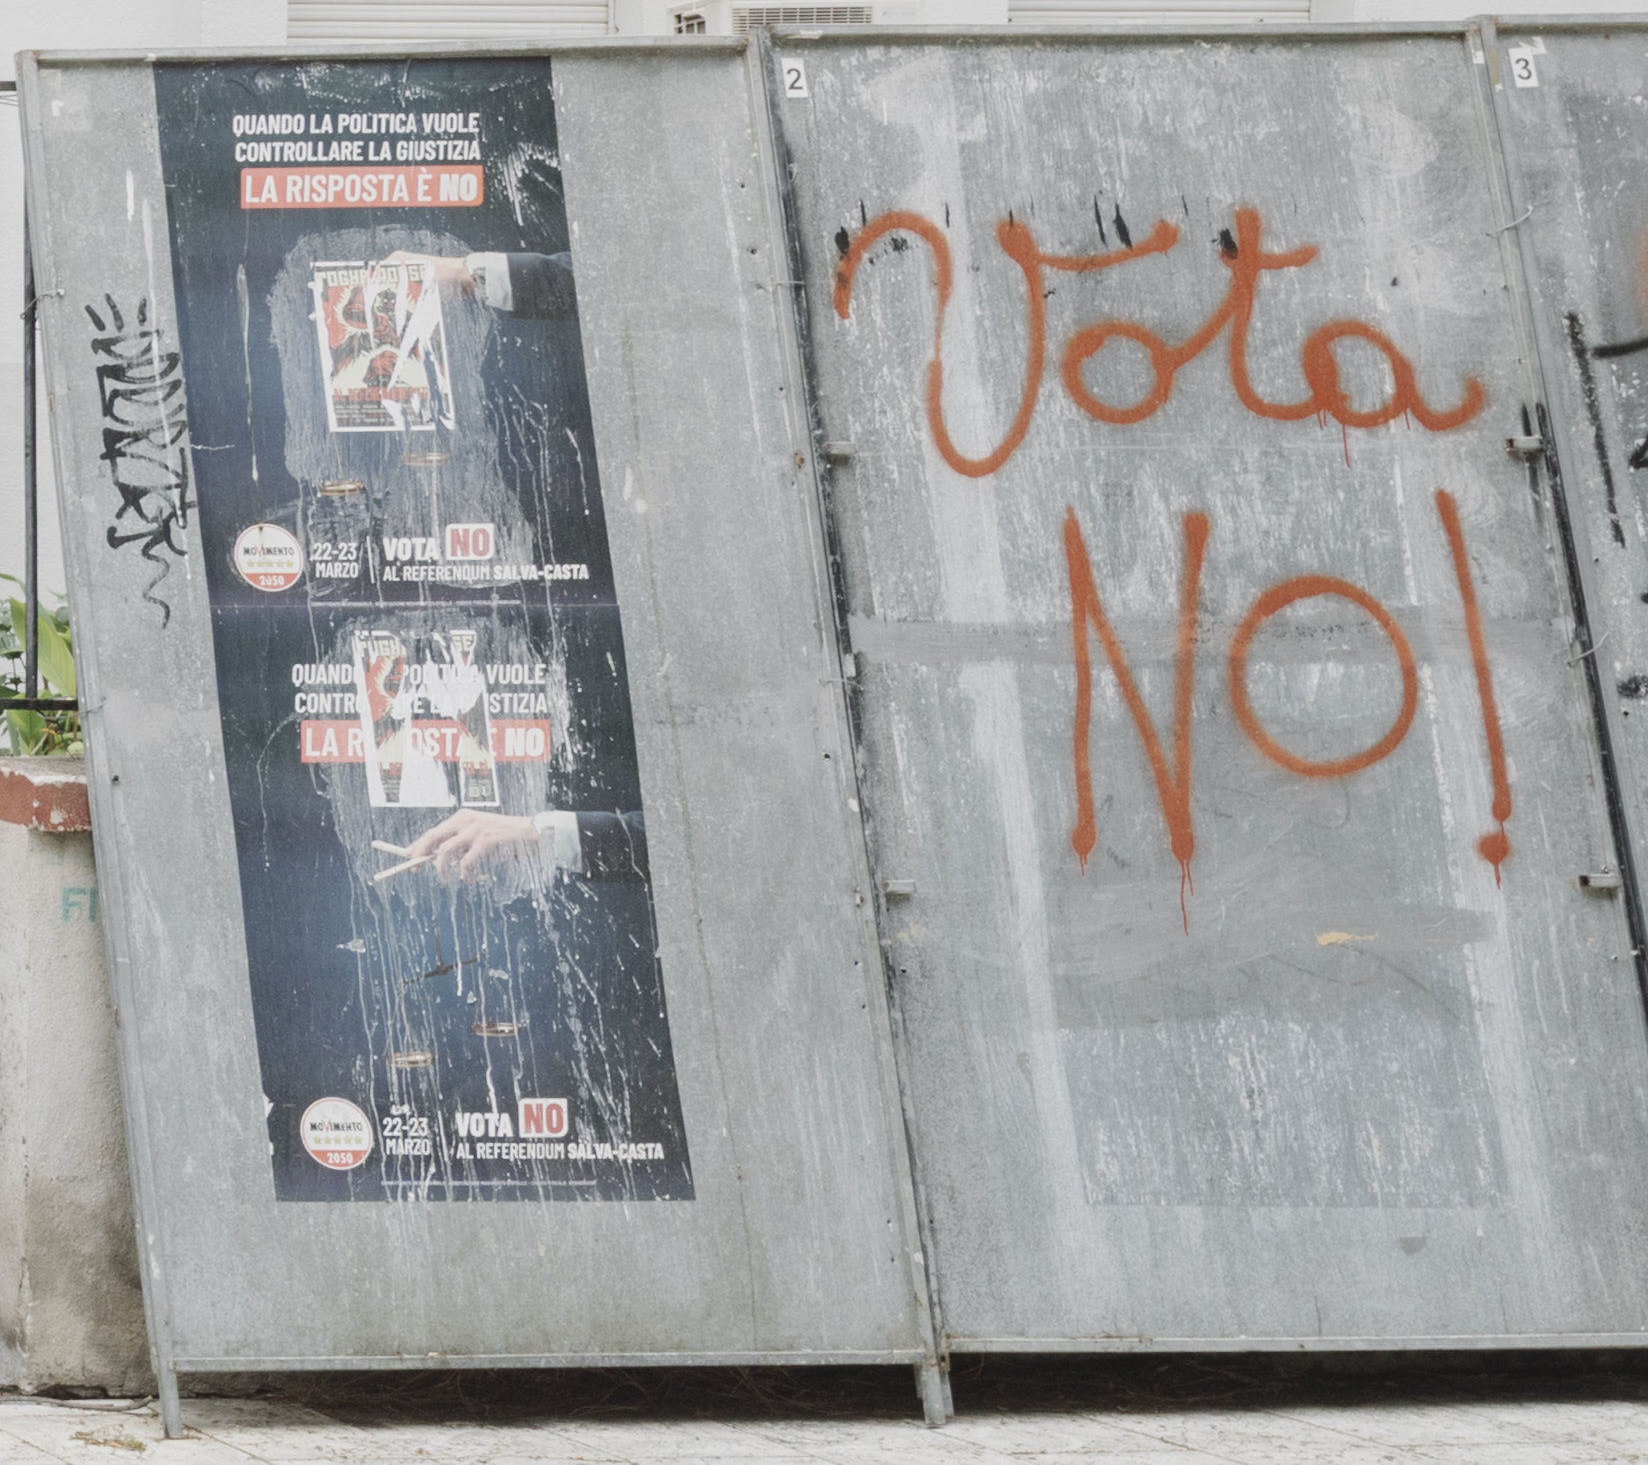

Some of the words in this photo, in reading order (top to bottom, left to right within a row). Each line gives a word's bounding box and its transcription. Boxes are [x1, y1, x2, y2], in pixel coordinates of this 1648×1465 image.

[786, 68, 804, 90] 2
[1513, 55, 1534, 82] 3
[232, 114, 306, 137] QUANDO
[309, 114, 333, 134] LA
[337, 113, 417, 134] POLITICA
[421, 113, 480, 133] VUOLE
[235, 141, 364, 162] CONTROLLARE
[368, 141, 392, 161] LA
[396, 140, 482, 161] GIUSTIZIA
[244, 174, 278, 203] LA
[285, 173, 410, 203] RISPOSTA
[417, 167, 433, 202] È
[439, 173, 478, 202] NO
[833, 207, 1486, 478] Vota
[243, 544, 295, 557] MOVIMENTO
[313, 542, 357, 562] 22-23
[382, 537, 439, 562] VOTA
[449, 528, 491, 557] NO
[259, 574, 285, 586] 2050
[315, 561, 359, 579] MARZO
[382, 566, 400, 582] AL
[402, 565, 491, 582] REFERENDUM
[493, 564, 590, 581] SALVA-CASTA
[486, 663, 547, 685] VUOLE
[1061, 487, 1512, 880] NO!
[304, 728, 339, 757] LA
[504, 727, 545, 757] NO
[310, 1120, 363, 1134] MOVIMENTO
[382, 1117, 429, 1137] 22-23
[456, 1112, 513, 1138] VOTA
[523, 1103, 564, 1134] NO
[385, 1138, 431, 1156] MARZO
[456, 1144, 475, 1160] AL
[476, 1144, 565, 1160] REFERENDUM
[567, 1143, 666, 1160] SALVA-CASTA
[327, 1152, 354, 1165] 2050
